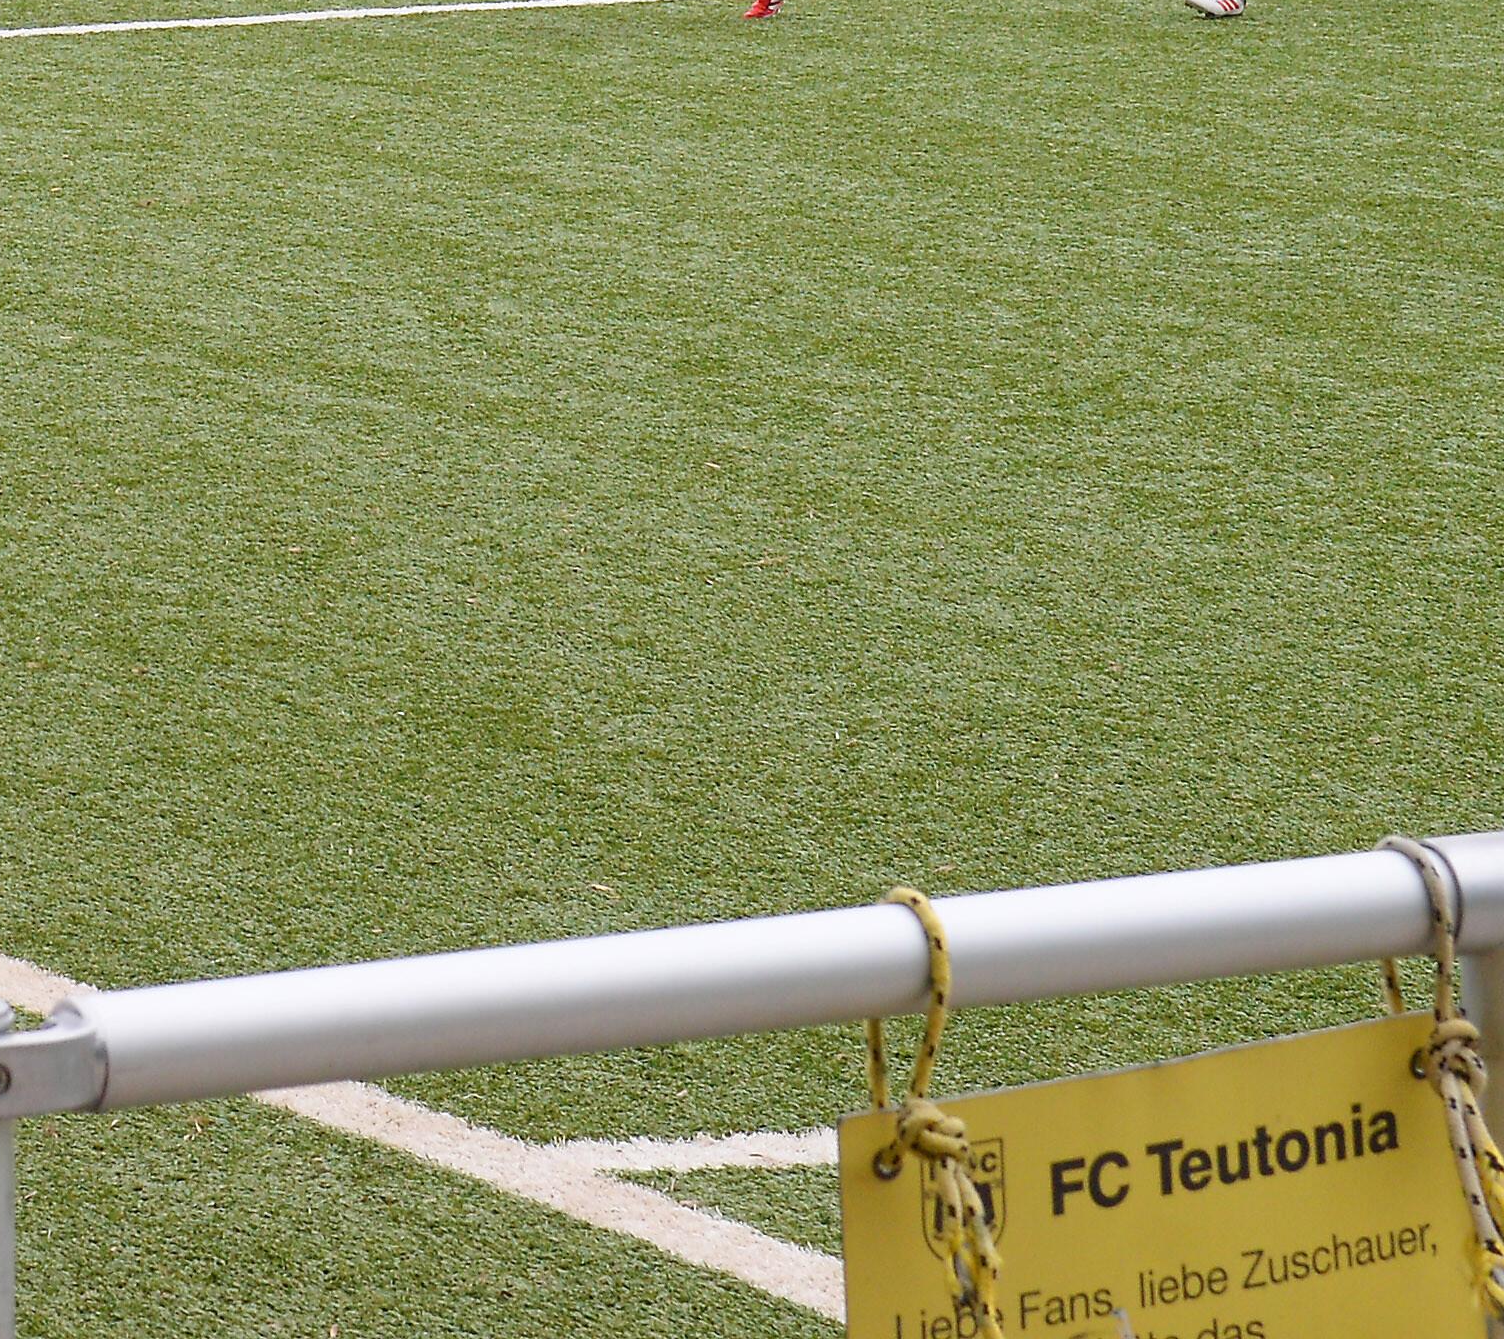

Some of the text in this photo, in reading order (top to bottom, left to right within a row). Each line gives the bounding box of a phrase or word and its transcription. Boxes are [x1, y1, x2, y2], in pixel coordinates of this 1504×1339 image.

[1050, 1102, 1400, 1216] FC Teutonia
[1138, 1262, 1229, 1308] liebe
[1241, 1222, 1439, 1290] Zuschauer,
